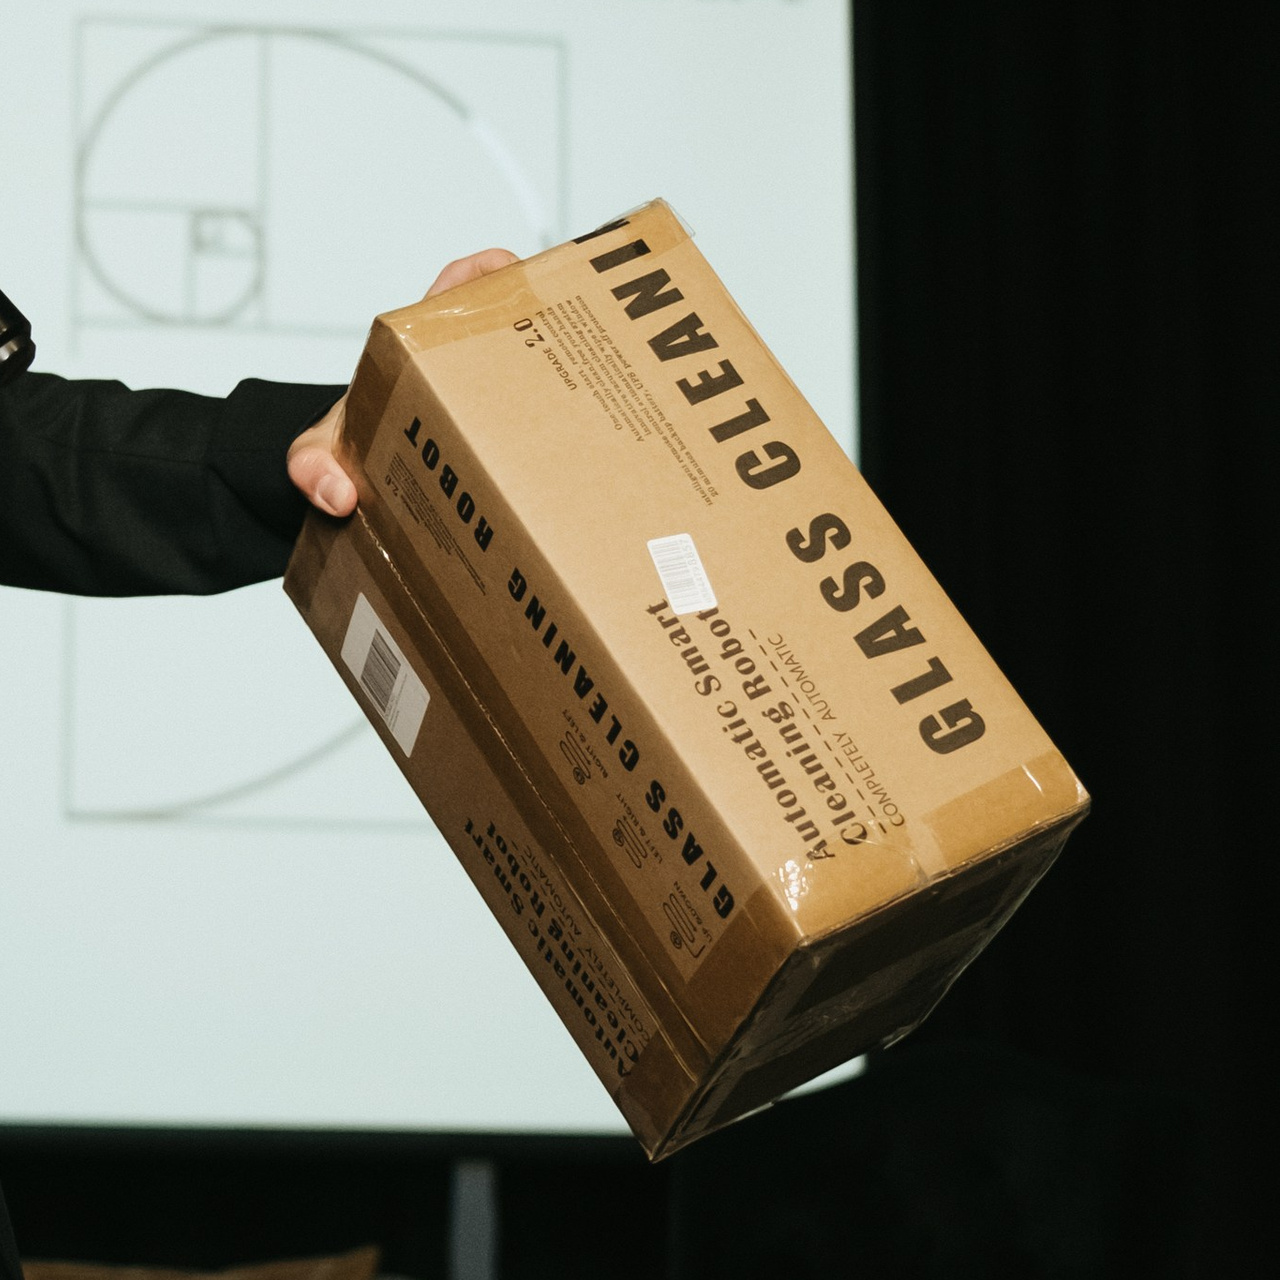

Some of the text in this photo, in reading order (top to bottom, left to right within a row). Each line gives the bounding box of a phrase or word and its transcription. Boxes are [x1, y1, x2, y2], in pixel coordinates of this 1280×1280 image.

[533, 308, 559, 338] control
[545, 305, 567, 332] hands
[555, 301, 579, 330] system
[564, 298, 588, 328] window
[574, 293, 607, 334] protection
[512, 316, 578, 391] UPGRADE 2.0
[555, 336, 579, 365] remote
[562, 329, 582, 349] your
[573, 328, 602, 363] cleaning
[589, 333, 606, 353] wipe
[609, 344, 633, 369] power
[597, 361, 622, 394] vacuum
[602, 352, 645, 407] automatically
[601, 386, 645, 442] Automatically
[638, 405, 665, 436] control
[660, 434, 684, 464] remote
[663, 420, 687, 452] backup
[404, 416, 493, 551] ROBOT
[786, 513, 984, 753] GLASS
[508, 568, 639, 770] CLEANING
[646, 599, 835, 860] Automatic Smart
[697, 607, 867, 845] Cleaning Robot
[767, 633, 905, 827] COMPLETELY AUTOMATIC
[645, 780, 734, 918] GLASS
[464, 817, 631, 1078] Automatic Smart
[485, 820, 639, 1063] Cleaning Robot
[522, 843, 651, 1045] COMPLETELY AUTOMATIC
